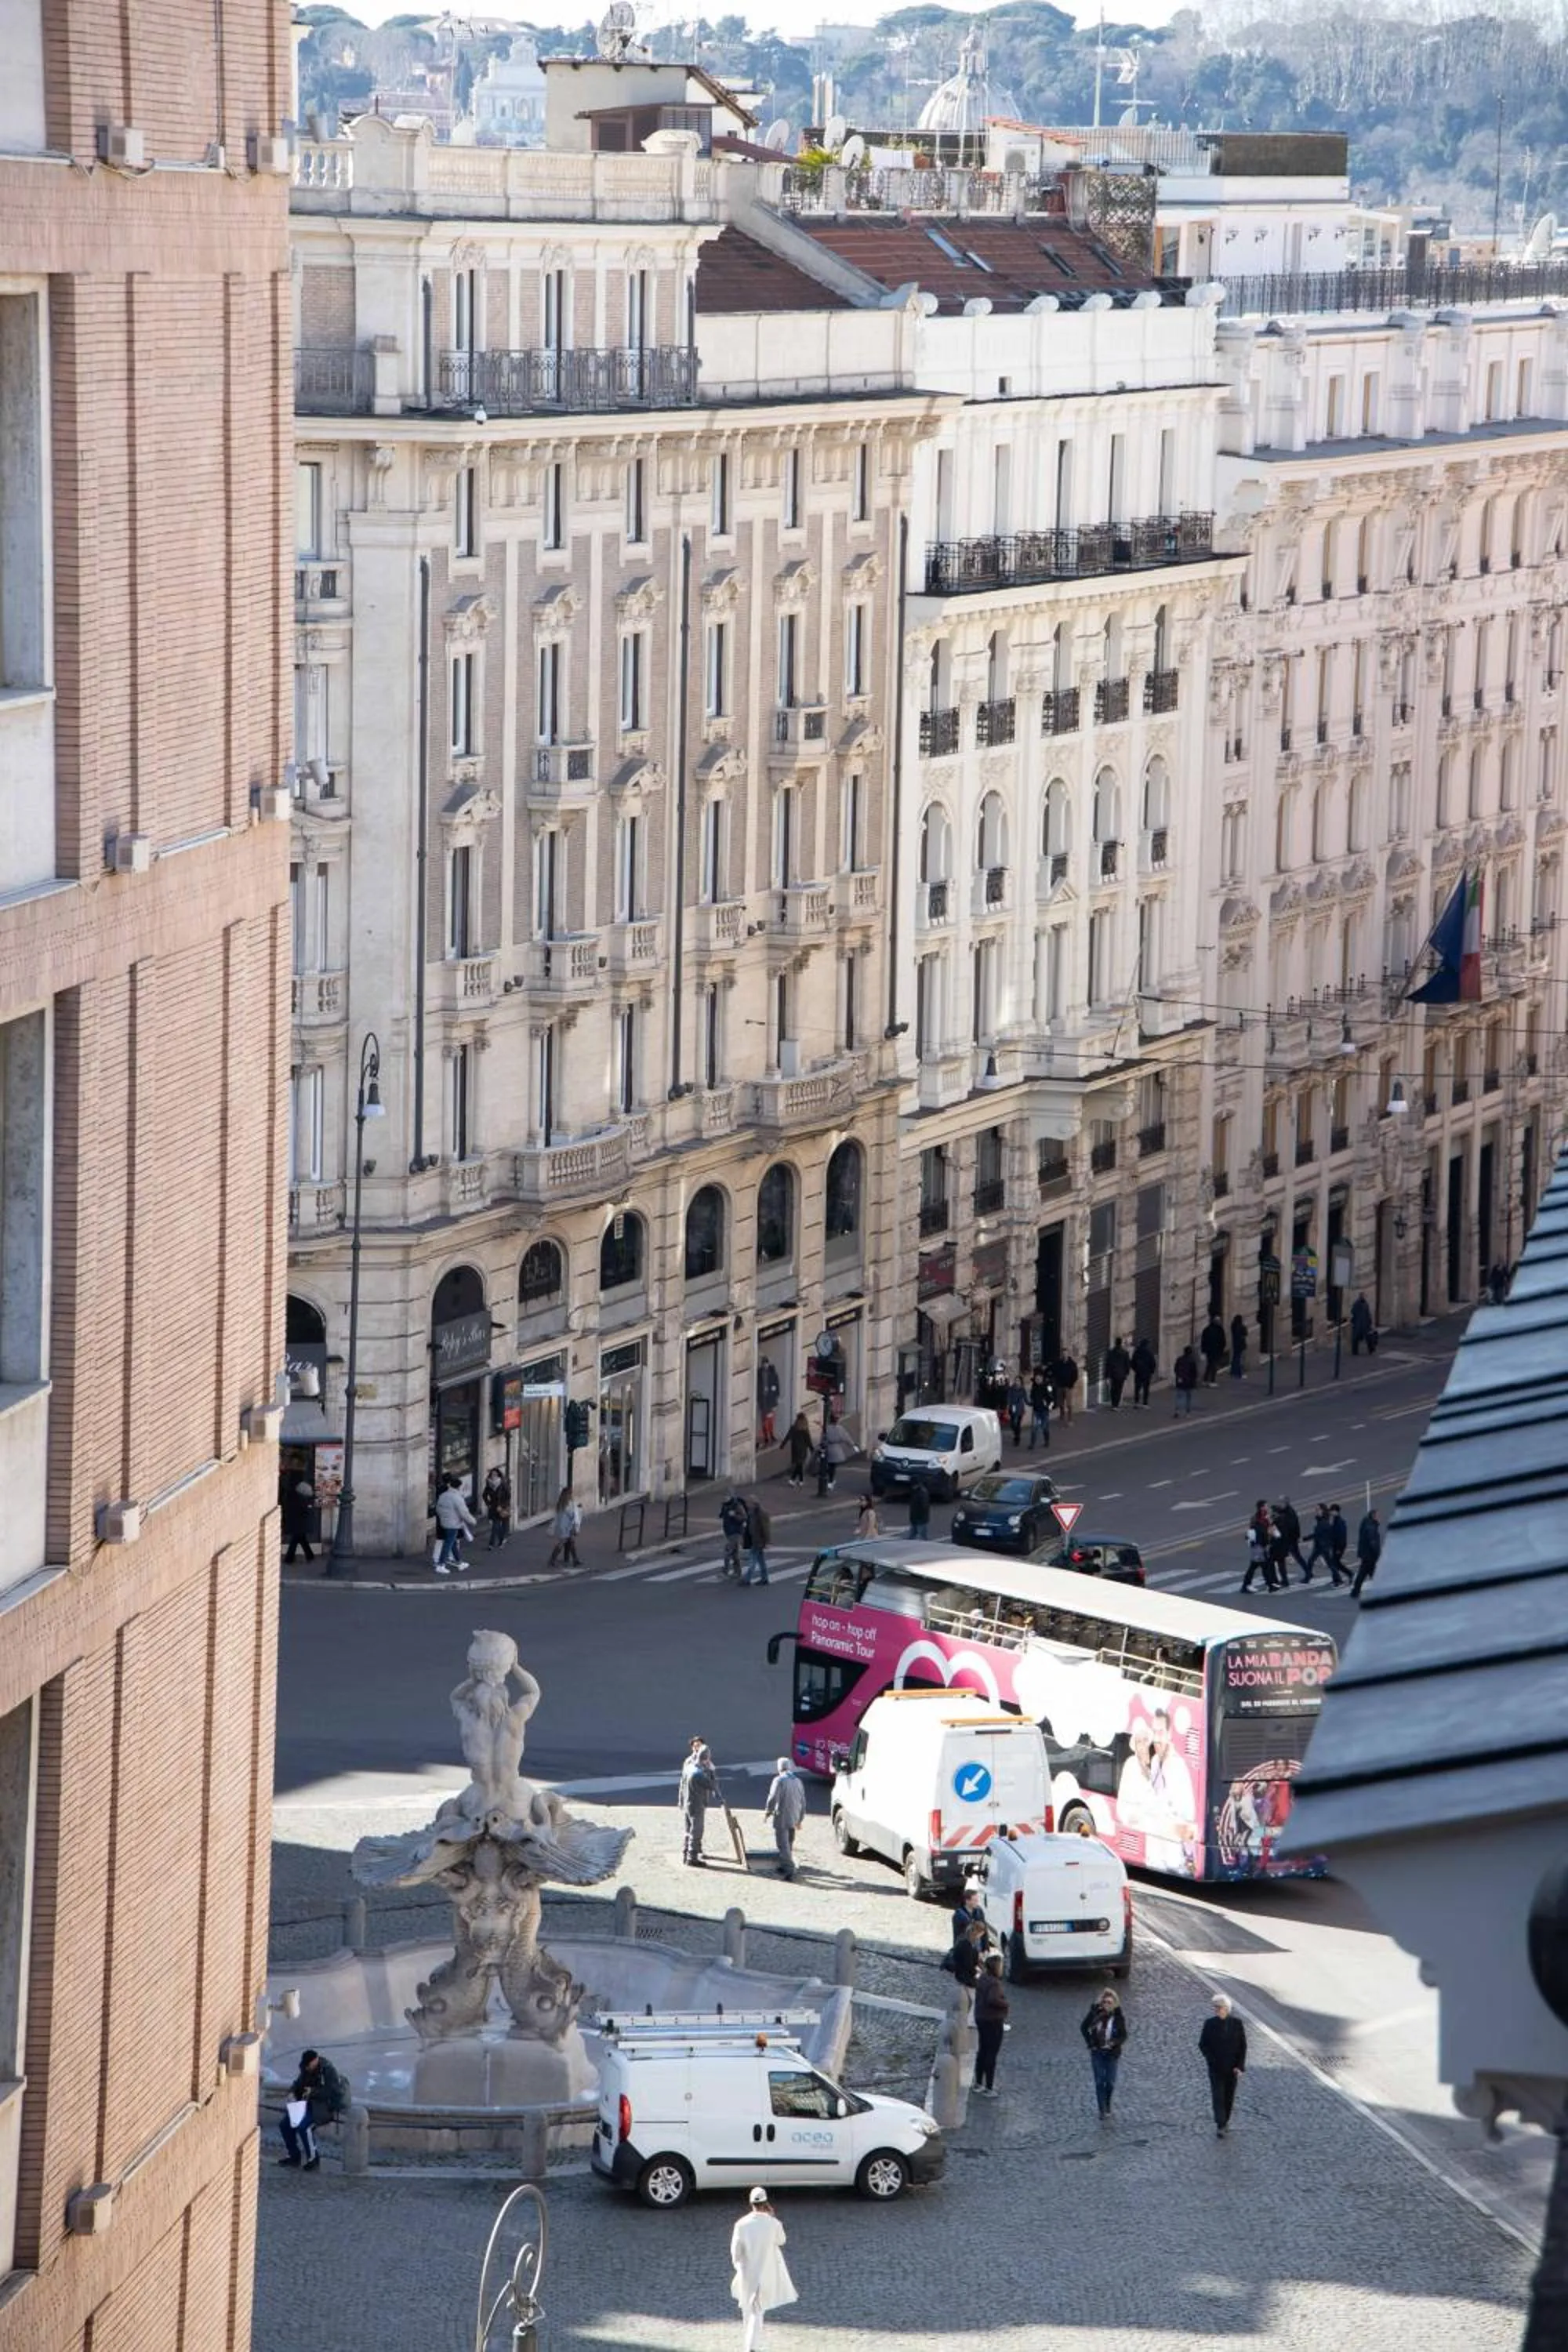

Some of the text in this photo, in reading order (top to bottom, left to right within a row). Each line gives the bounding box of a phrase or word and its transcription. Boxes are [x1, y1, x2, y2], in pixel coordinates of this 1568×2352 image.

[811, 1614, 828, 1631] hop
[829, 1620, 840, 1631] on
[848, 1622, 863, 1640] hop
[865, 1627, 877, 1641] off
[811, 1631, 876, 1658] Panoramic Tour
[1228, 1650, 1332, 1669] LA MIA BANDA
[1229, 1668, 1332, 1686] SUONA IL POP
[792, 2132, 833, 2143] acea
